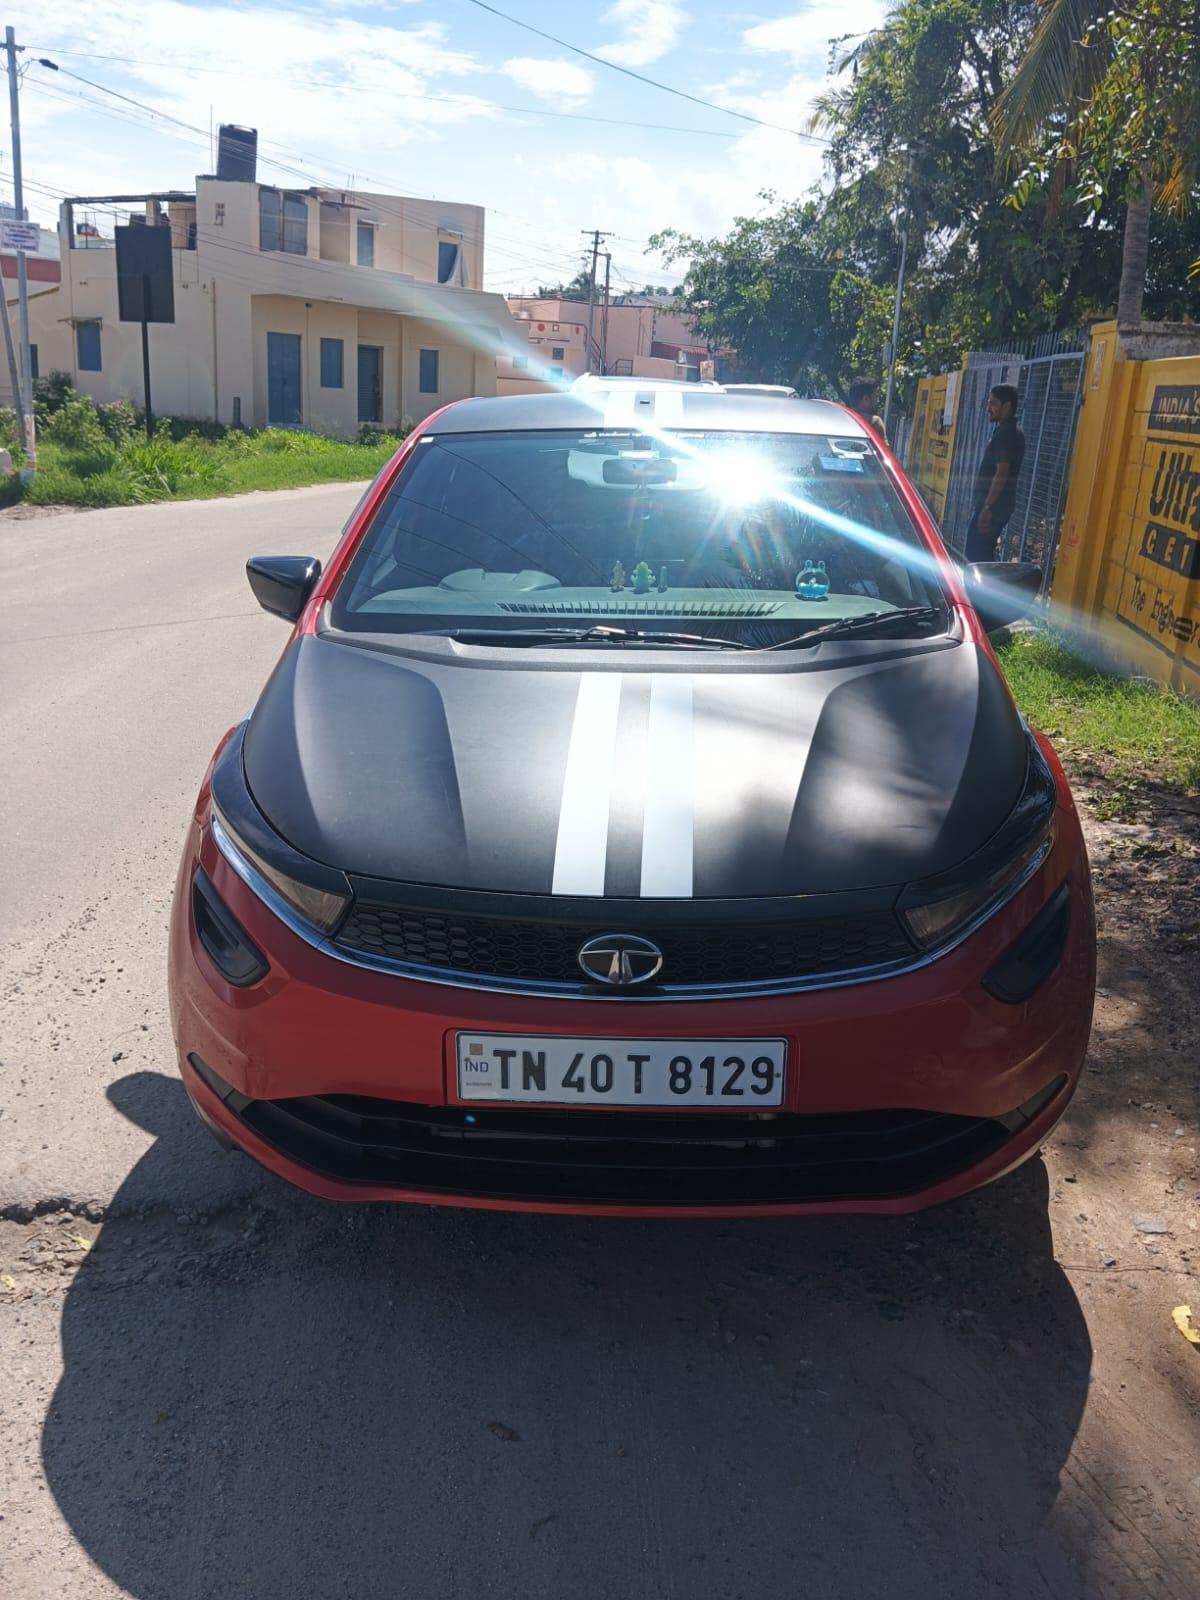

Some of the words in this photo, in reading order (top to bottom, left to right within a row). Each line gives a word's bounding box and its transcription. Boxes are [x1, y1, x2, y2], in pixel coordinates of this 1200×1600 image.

[465, 1060, 489, 1073] IND
[493, 1049, 546, 1091] TN
[561, 1053, 613, 1093] 40
[627, 1055, 650, 1094] T
[669, 1056, 774, 1096] 8129
